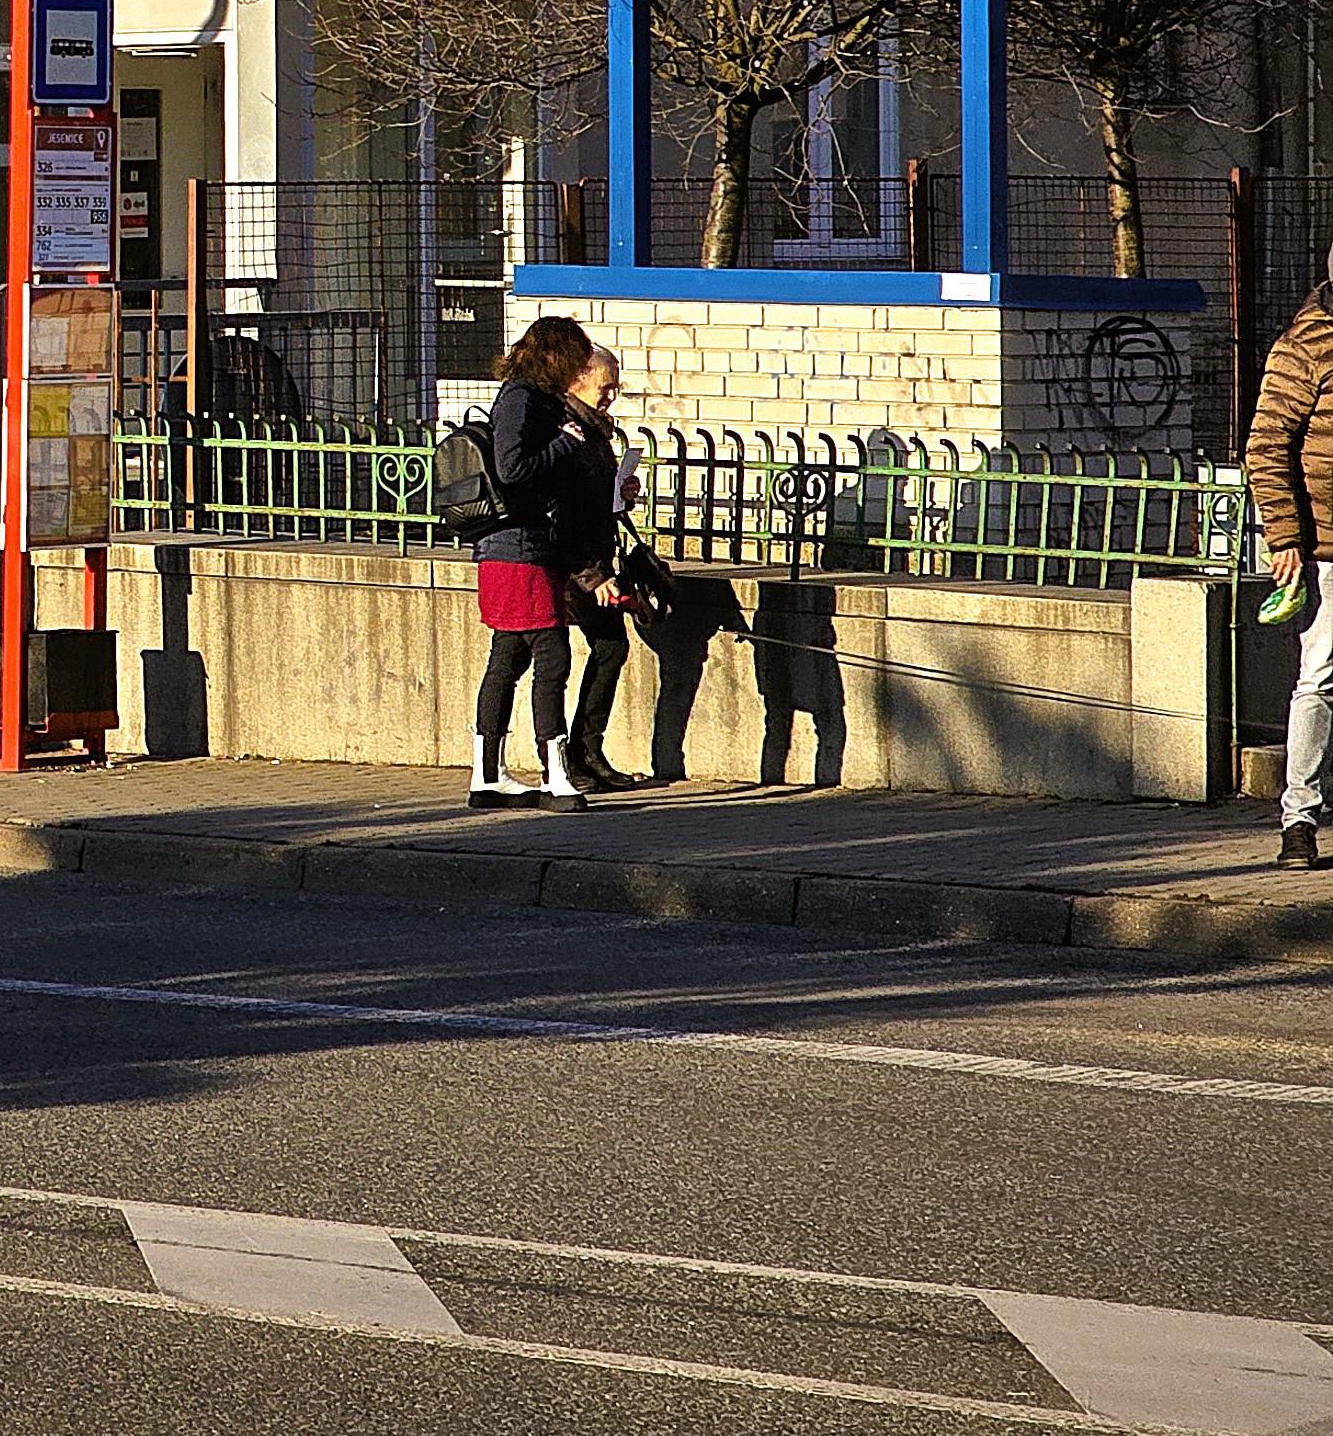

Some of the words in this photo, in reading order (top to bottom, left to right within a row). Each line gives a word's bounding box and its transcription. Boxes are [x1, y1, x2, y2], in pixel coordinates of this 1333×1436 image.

[47, 132, 84, 144] JESENICE
[37, 161, 53, 173] 326
[36, 196, 53, 208] 332
[55, 196, 72, 208] 335
[74, 196, 90, 208] 337
[92, 211, 108, 223] 956
[36, 225, 52, 237] 334
[36, 240, 52, 251] 762
